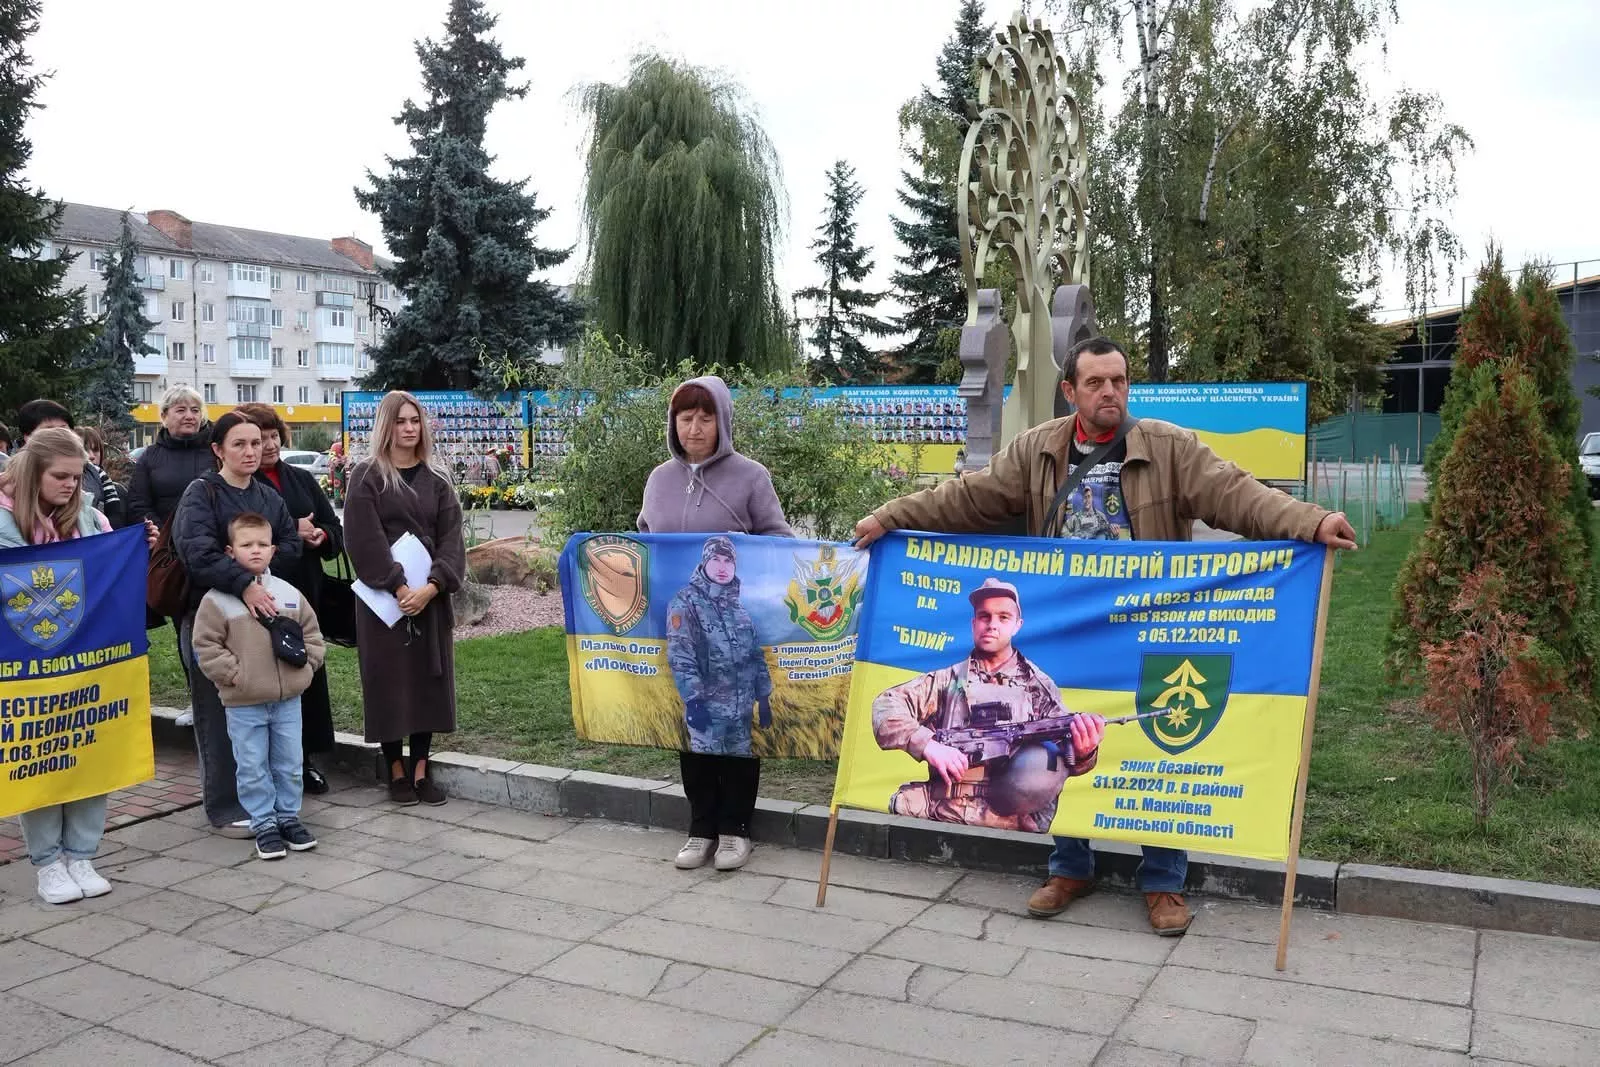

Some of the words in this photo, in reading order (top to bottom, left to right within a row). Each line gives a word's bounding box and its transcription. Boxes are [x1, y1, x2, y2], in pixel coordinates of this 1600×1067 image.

[1128, 387, 1154, 395] ТАЄМО
[1158, 387, 1200, 395] КОЖНОГО,
[1222, 387, 1264, 395] ЗАХИЩАВ
[906, 536, 1065, 576] БАРАНІВСЬКИЙ
[1069, 551, 1164, 579] ВАЛЕРІЙ
[1169, 548, 1294, 578] ПЕТРОВИЧ
[900, 571, 960, 594] 19.10.1973
[916, 595, 938, 610] р.н.
[1114, 593, 1138, 607] в/ч
[1153, 591, 1190, 606] 4823
[1193, 589, 1210, 603] 31
[1213, 586, 1275, 602] бригада
[1109, 613, 1127, 623] на
[1187, 609, 1206, 622] не
[781, 637, 853, 655] прикордонний
[892, 625, 954, 651] "БІЛИЙ"
[1149, 627, 1225, 643] 05.12.2024
[1228, 629, 1241, 644] р.
[581, 639, 627, 653] Малько
[629, 643, 661, 655] Олег
[28, 659, 39, 675] А
[42, 655, 75, 674] 5001
[77, 641, 132, 667] ЧАСТИНА
[779, 657, 801, 667] імені
[803, 656, 834, 668] Героя
[788, 669, 829, 680] Євгенія
[1, 683, 100, 718] ЕСТЕРЕНКО
[2, 719, 14, 743] Й
[19, 698, 128, 740] ЛЕОНІДОВИЧ
[0, 735, 69, 764] 1.08.1979
[72, 729, 96, 748] Р.Н.
[9, 753, 76, 781] «СОКОЛ»
[1120, 759, 1156, 773] зник
[1157, 759, 1224, 777] безвісти
[1093, 775, 1165, 793] 31.12.2024
[1165, 780, 1177, 794] р.
[1180, 782, 1190, 794] в
[1191, 781, 1244, 799] районі
[1114, 797, 1139, 811] н.п.
[1141, 797, 1212, 816] Макиївка
[1093, 813, 1174, 834] Луганської
[1176, 820, 1234, 839] області
